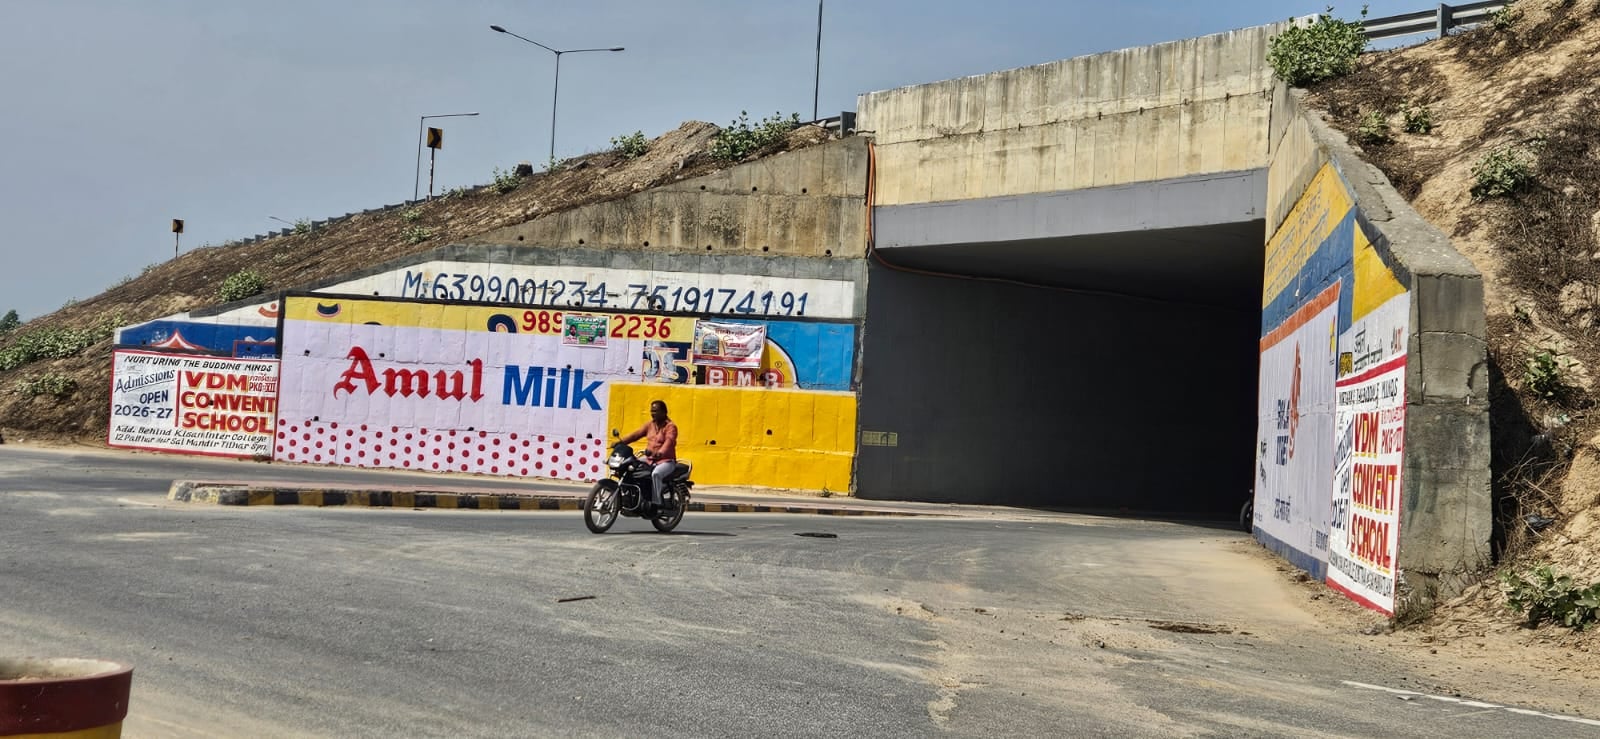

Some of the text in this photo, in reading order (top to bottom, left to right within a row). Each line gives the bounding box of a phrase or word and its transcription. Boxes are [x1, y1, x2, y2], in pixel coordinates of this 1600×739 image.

[522, 311, 672, 339] 9892236
[125, 355, 273, 372] NURTURING THE BUDDING MINDS
[114, 369, 175, 393] Admissions
[184, 370, 248, 392] VDM
[333, 346, 604, 411] Amul Milk
[139, 389, 169, 405] OPEN
[180, 391, 276, 413] CONVENT
[114, 404, 173, 419] 2026-27
[182, 411, 274, 434] SCHOOL
[138, 426, 172, 436] Behind
[205, 431, 231, 441] Inter
[231, 433, 268, 443] College
[186, 438, 220, 448] Mandir
[1354, 411, 1380, 454] VDM
[1352, 463, 1398, 511] CONVENT
[1351, 513, 1391, 569] SCHOOL
